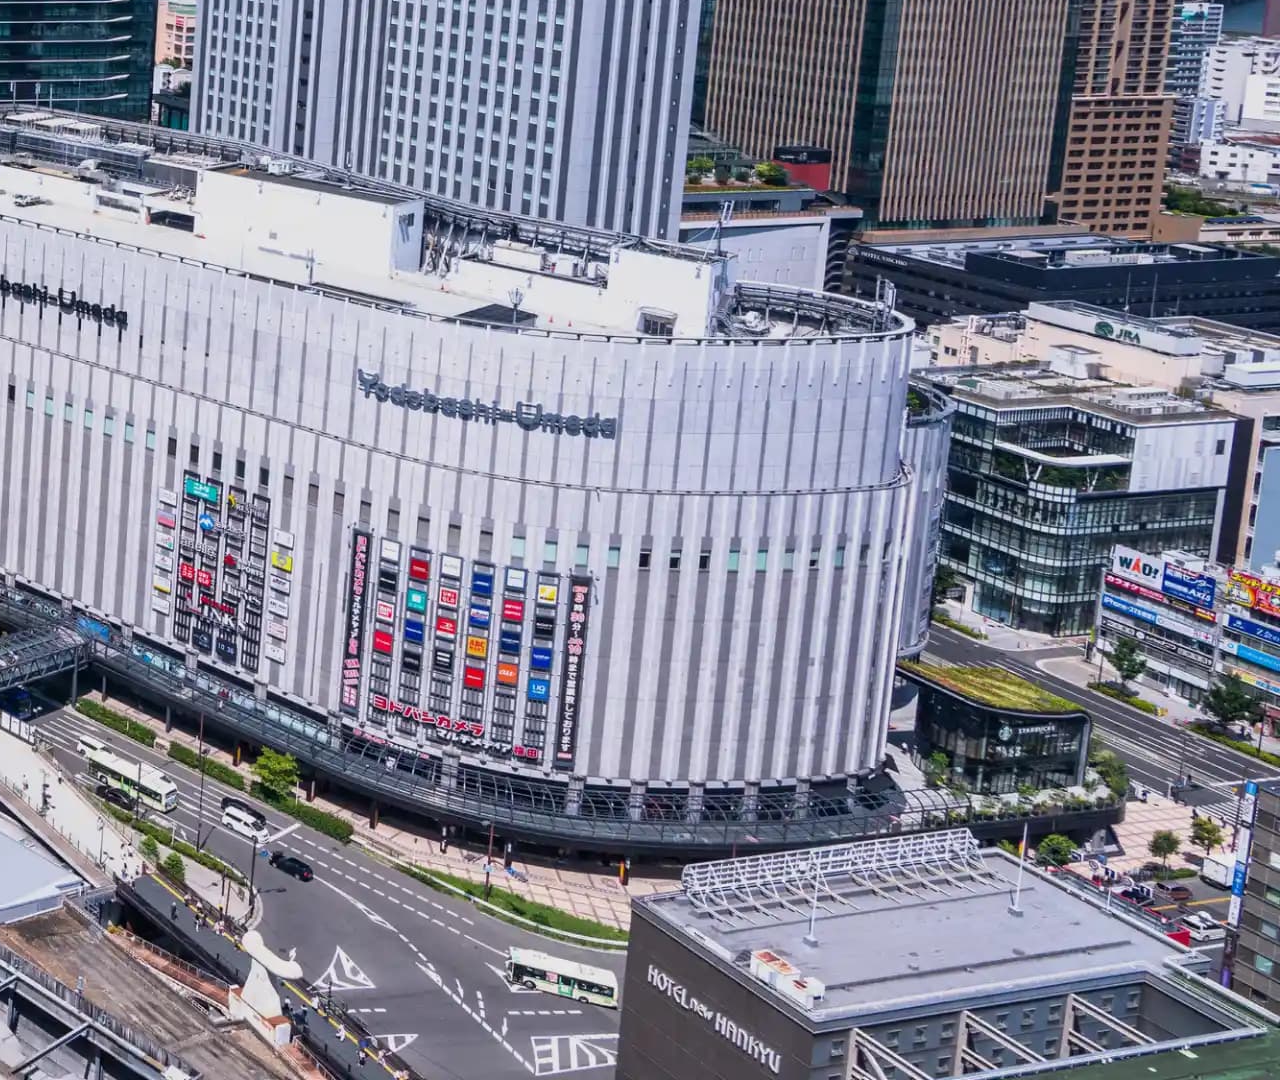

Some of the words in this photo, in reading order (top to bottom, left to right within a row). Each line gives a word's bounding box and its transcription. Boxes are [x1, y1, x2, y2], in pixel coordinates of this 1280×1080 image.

[1116, 329, 1141, 344] JRA
[373, 695, 485, 737] ヨドバシカメラ
[647, 964, 689, 1010] HOTEL
[689, 997, 714, 1021] new
[714, 1012, 782, 1074] HANKYU
